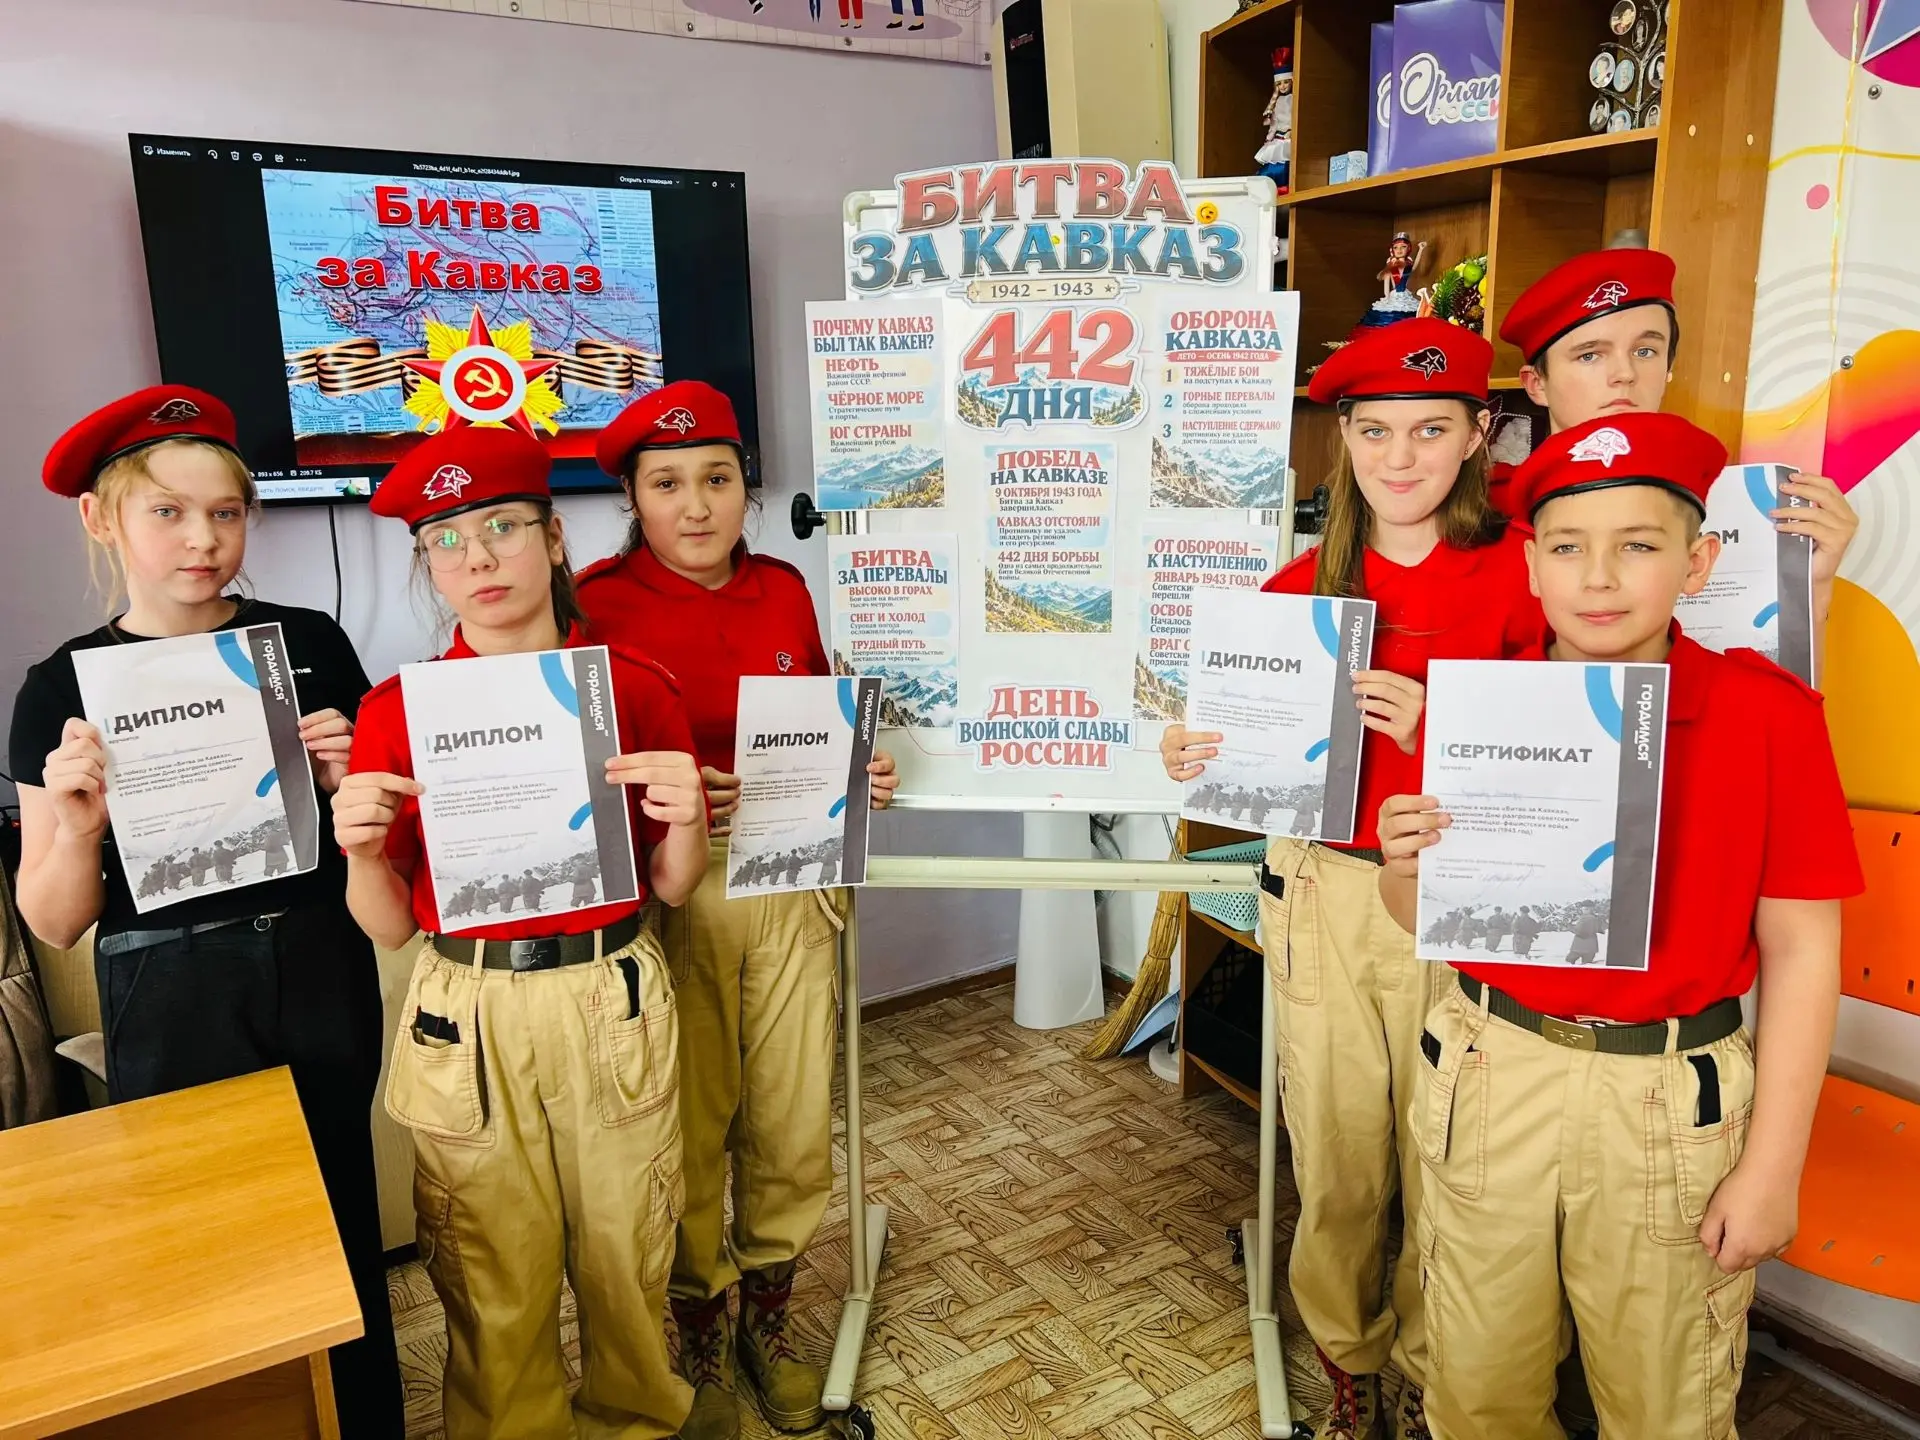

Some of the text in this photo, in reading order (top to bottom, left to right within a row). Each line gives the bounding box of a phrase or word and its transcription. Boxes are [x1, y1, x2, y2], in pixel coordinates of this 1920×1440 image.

[157, 148, 191, 156] Изменить
[620, 176, 642, 185] Открыть
[897, 163, 1194, 233] БИТВА
[374, 185, 541, 232] Битва
[850, 223, 1244, 290] ЗА КАВКАЗ
[316, 256, 388, 289] за
[406, 250, 603, 294] Кавказ
[991, 282, 1093, 298] 1942 1943
[813, 316, 934, 336] ПОЧЕМУ КАВКАЗ
[1170, 310, 1277, 331] ОБОРОНА
[814, 334, 934, 352] БЫЛ ТАК ВАЖЕН?
[1165, 329, 1283, 351] КАВКАЗА
[963, 309, 1135, 387] 442
[1207, 352, 1231, 360] ОСЕНЬ
[1250, 352, 1269, 360] ГОДА
[825, 358, 879, 372] НЕФТЬ
[1184, 365, 1260, 377] ТЯЖЁЛЫЕ БОИ
[1166, 369, 1172, 382] 1
[828, 391, 924, 406] ЧЁРНОЕ МОРЕ
[1164, 394, 1173, 408] 2
[1183, 391, 1275, 401] ГОРНЫЕ ПЕРЕВАЛЫ
[997, 387, 1093, 428] ДНЯ
[830, 425, 911, 439] ЮГ СТРАНЫ
[1163, 424, 1172, 438] 3
[1182, 421, 1281, 431] НАСТУПЛЕНИЕ СДЕРЖАНО
[997, 450, 1101, 471] ПОБЕДА
[990, 468, 1108, 486] НА КАВКАЗЕ
[995, 487, 1102, 498] 9 ОКТЯБРЯ 1943 ГОДА
[996, 516, 1100, 527] КАВКАЗ ОТСТОЯЛИ
[1154, 539, 1248, 556] ОТ ОБОРОНЫ
[851, 549, 934, 568] БИТВА
[998, 551, 1099, 563] 442 ДНЯ БОРЬБЫ
[1147, 554, 1268, 572] К НАСТУПЛЕНИЮ
[838, 566, 948, 585] ЗА ПЕРЕВАЛЫ
[1154, 572, 1200, 584] ЯНВАРЬ
[1201, 573, 1226, 585] 1943
[1229, 574, 1259, 587] ГОДА
[849, 585, 933, 596] ВЫСОКО В ГОРАХ
[1152, 582, 1194, 592] Советски
[1152, 592, 1190, 601] перешли
[850, 612, 926, 624] СНЕГ И ХОЛОД
[1150, 604, 1193, 617] ОСВОБ
[1151, 616, 1192, 626] Началось
[1150, 624, 1191, 635] Северног
[851, 638, 926, 650] ТРУДНЫЙ ПУТЬ
[1150, 638, 1181, 650] ВРАГ
[1149, 650, 1190, 659] Советски
[1149, 659, 1190, 667] продвига
[1207, 651, 1302, 674] ДИПЛОМ
[987, 687, 1100, 720] ДЕНЬ
[114, 698, 225, 735] ДИПЛОМ
[959, 718, 1129, 744] ВОИНСКОЙ СЛАВЫ
[434, 724, 543, 754] ДИПЛОМ
[752, 731, 829, 750] ДИПЛОМ
[980, 742, 1108, 768] РОССИИ
[1447, 743, 1593, 763] СЕРТИФИКАТ
